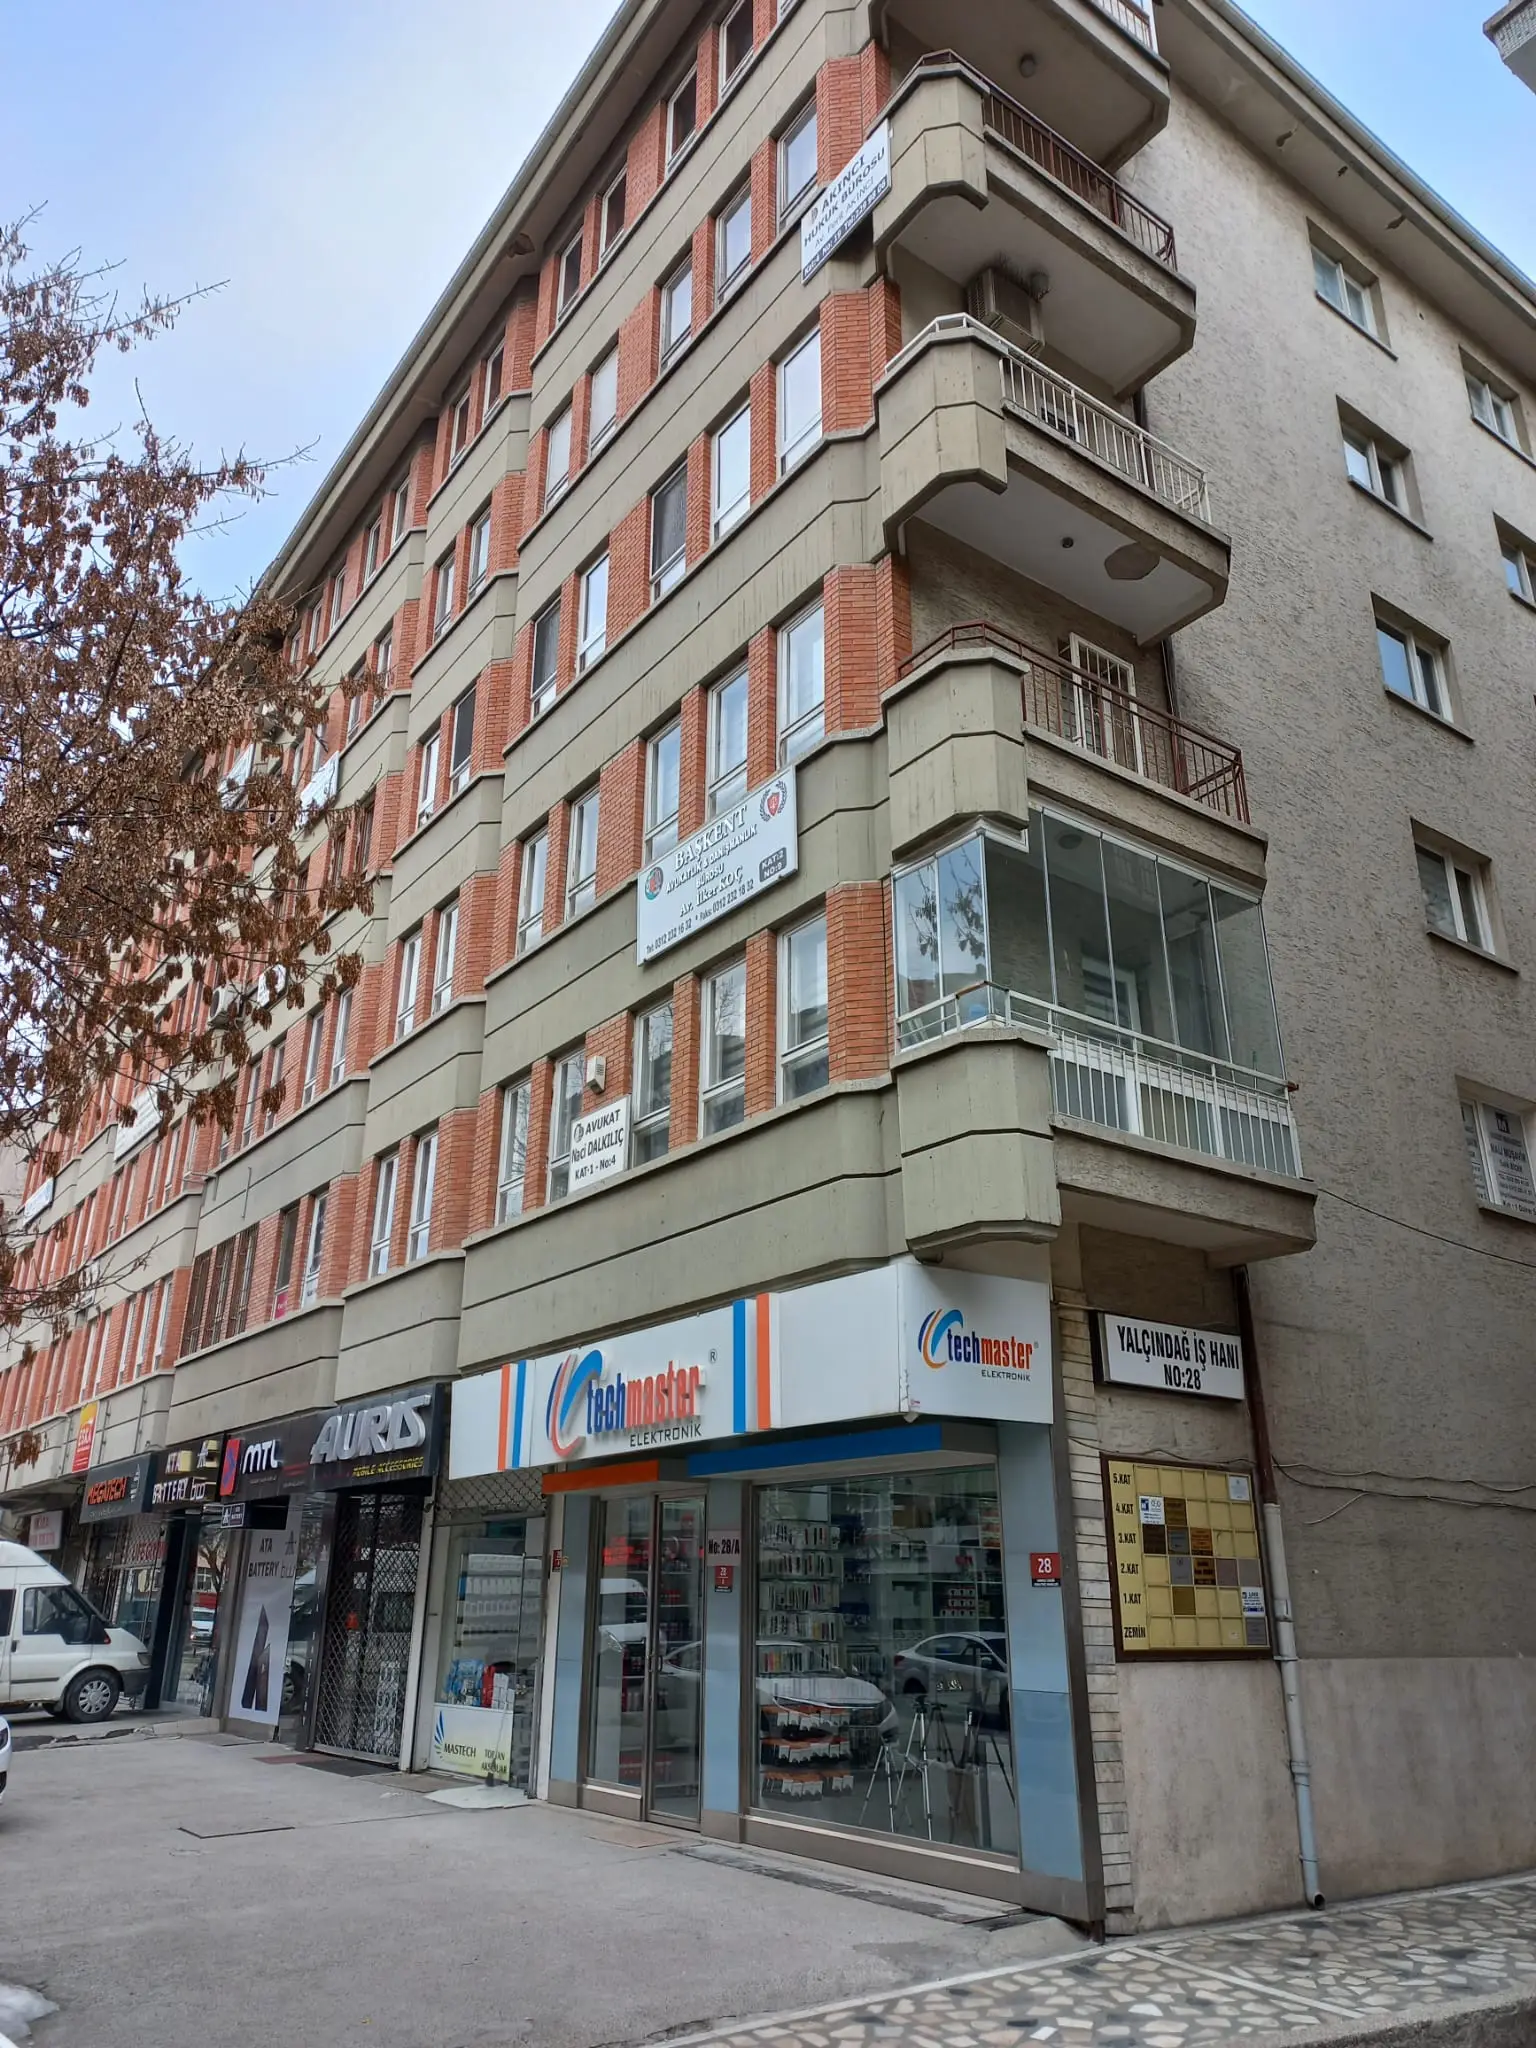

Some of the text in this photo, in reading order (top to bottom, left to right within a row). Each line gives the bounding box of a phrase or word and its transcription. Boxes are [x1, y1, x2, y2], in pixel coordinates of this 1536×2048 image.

[804, 147, 885, 247] HUKUK BÜROSU
[674, 804, 747, 872] BAŞKENT
[719, 865, 744, 892] KOÇ
[585, 1109, 621, 1136] AVUKAT
[587, 1127, 624, 1157] DALKILIÇ
[947, 1328, 1033, 1370] techmaster
[1117, 1324, 1240, 1371] YALÇINDAĞ İŞ HANI
[1163, 1363, 1201, 1390] NO:28
[587, 1360, 700, 1435] techmaster
[629, 1420, 702, 1447] ELEKTRONİK
[152, 1477, 189, 1504] BATTERY
[1113, 1473, 1131, 1485] 5.KAT
[1115, 1503, 1134, 1515] 4.KAT
[259, 1537, 273, 1553] ATA
[1118, 1532, 1136, 1544] 3.KAT
[248, 1561, 280, 1578] BATTERY
[1037, 1558, 1052, 1573] 28
[1120, 1563, 1139, 1575] 2.KAT
[1123, 1592, 1141, 1605] 1.KAT
[1124, 1625, 1146, 1639] ZEMİN
[444, 1743, 477, 1758] MASTECH
